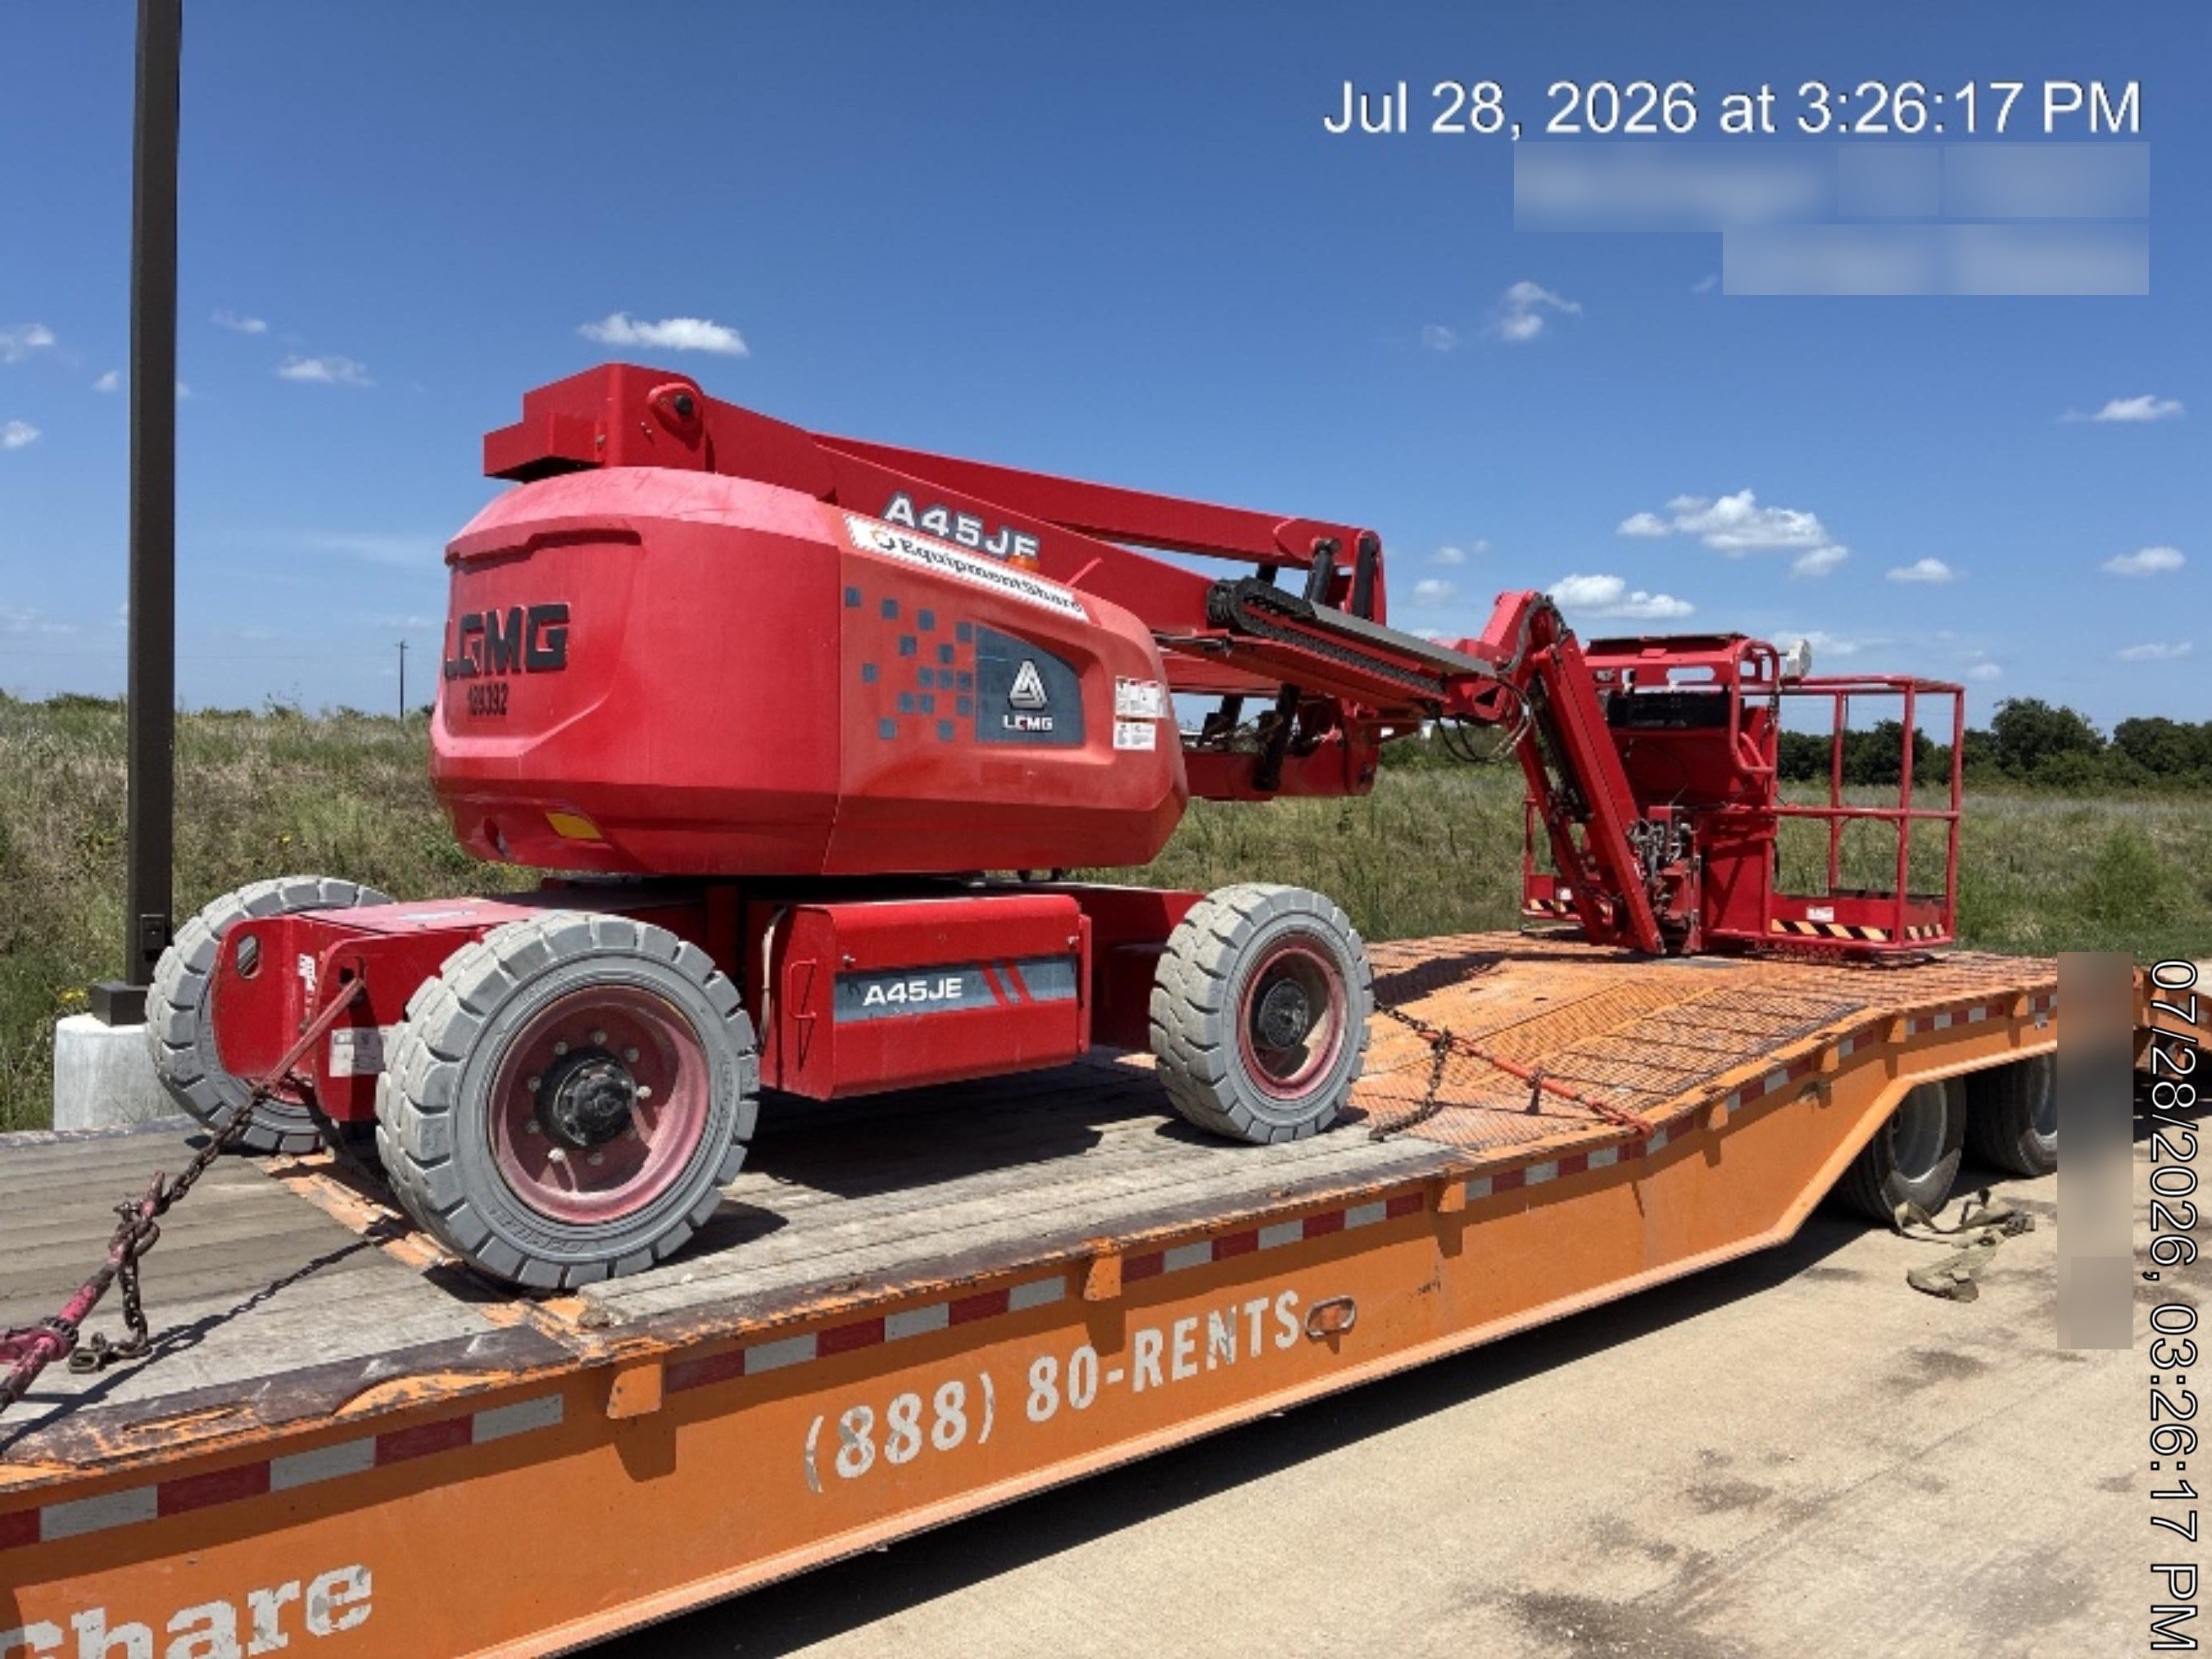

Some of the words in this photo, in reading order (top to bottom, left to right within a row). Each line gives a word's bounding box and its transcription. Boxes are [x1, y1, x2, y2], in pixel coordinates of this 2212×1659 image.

[445, 603, 569, 682] LGMG
[862, 977, 963, 1007] A45JE
[804, 1372, 995, 1494] (888)
[1026, 1290, 1301, 1423] 80-RENTS
